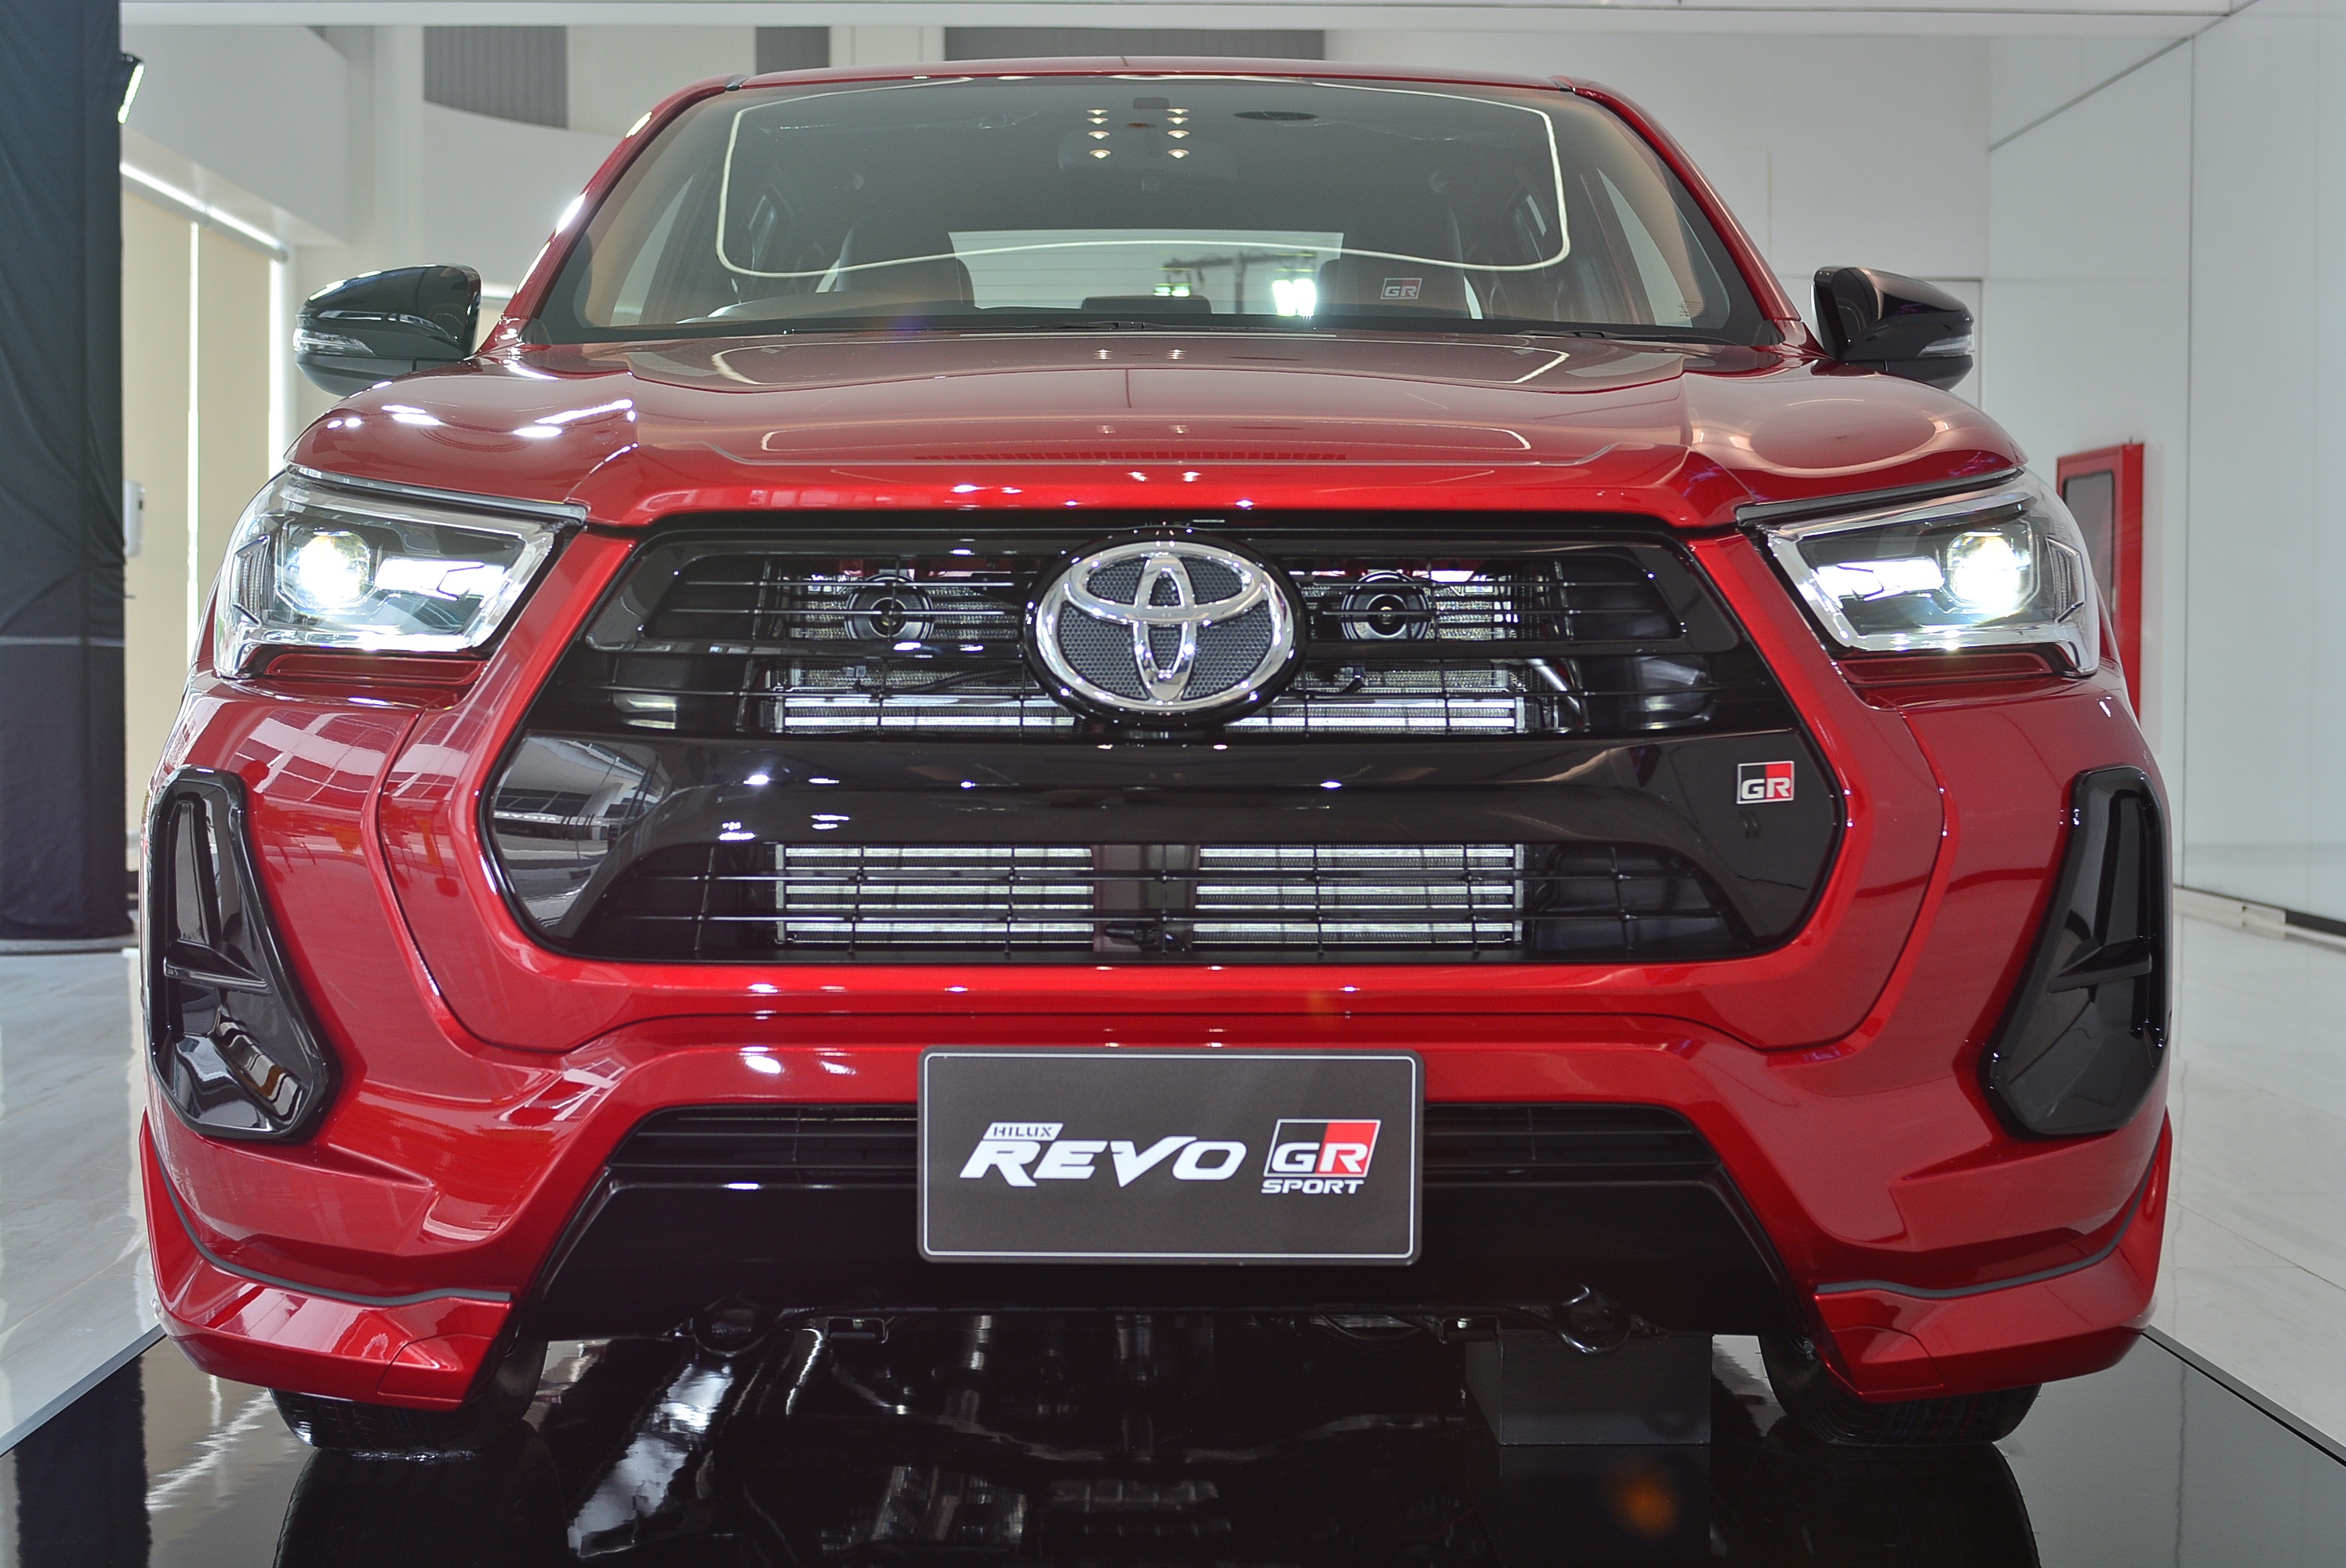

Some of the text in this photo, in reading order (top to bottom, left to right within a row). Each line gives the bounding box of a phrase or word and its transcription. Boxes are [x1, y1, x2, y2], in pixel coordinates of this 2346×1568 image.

[1384, 286, 1418, 297] GR
[1741, 777, 1791, 800] GR
[993, 1127, 1052, 1137] HILUX
[960, 1136, 1247, 1188] REVO
[1272, 1142, 1368, 1173] GR
[1261, 1179, 1364, 1194] SPORT
